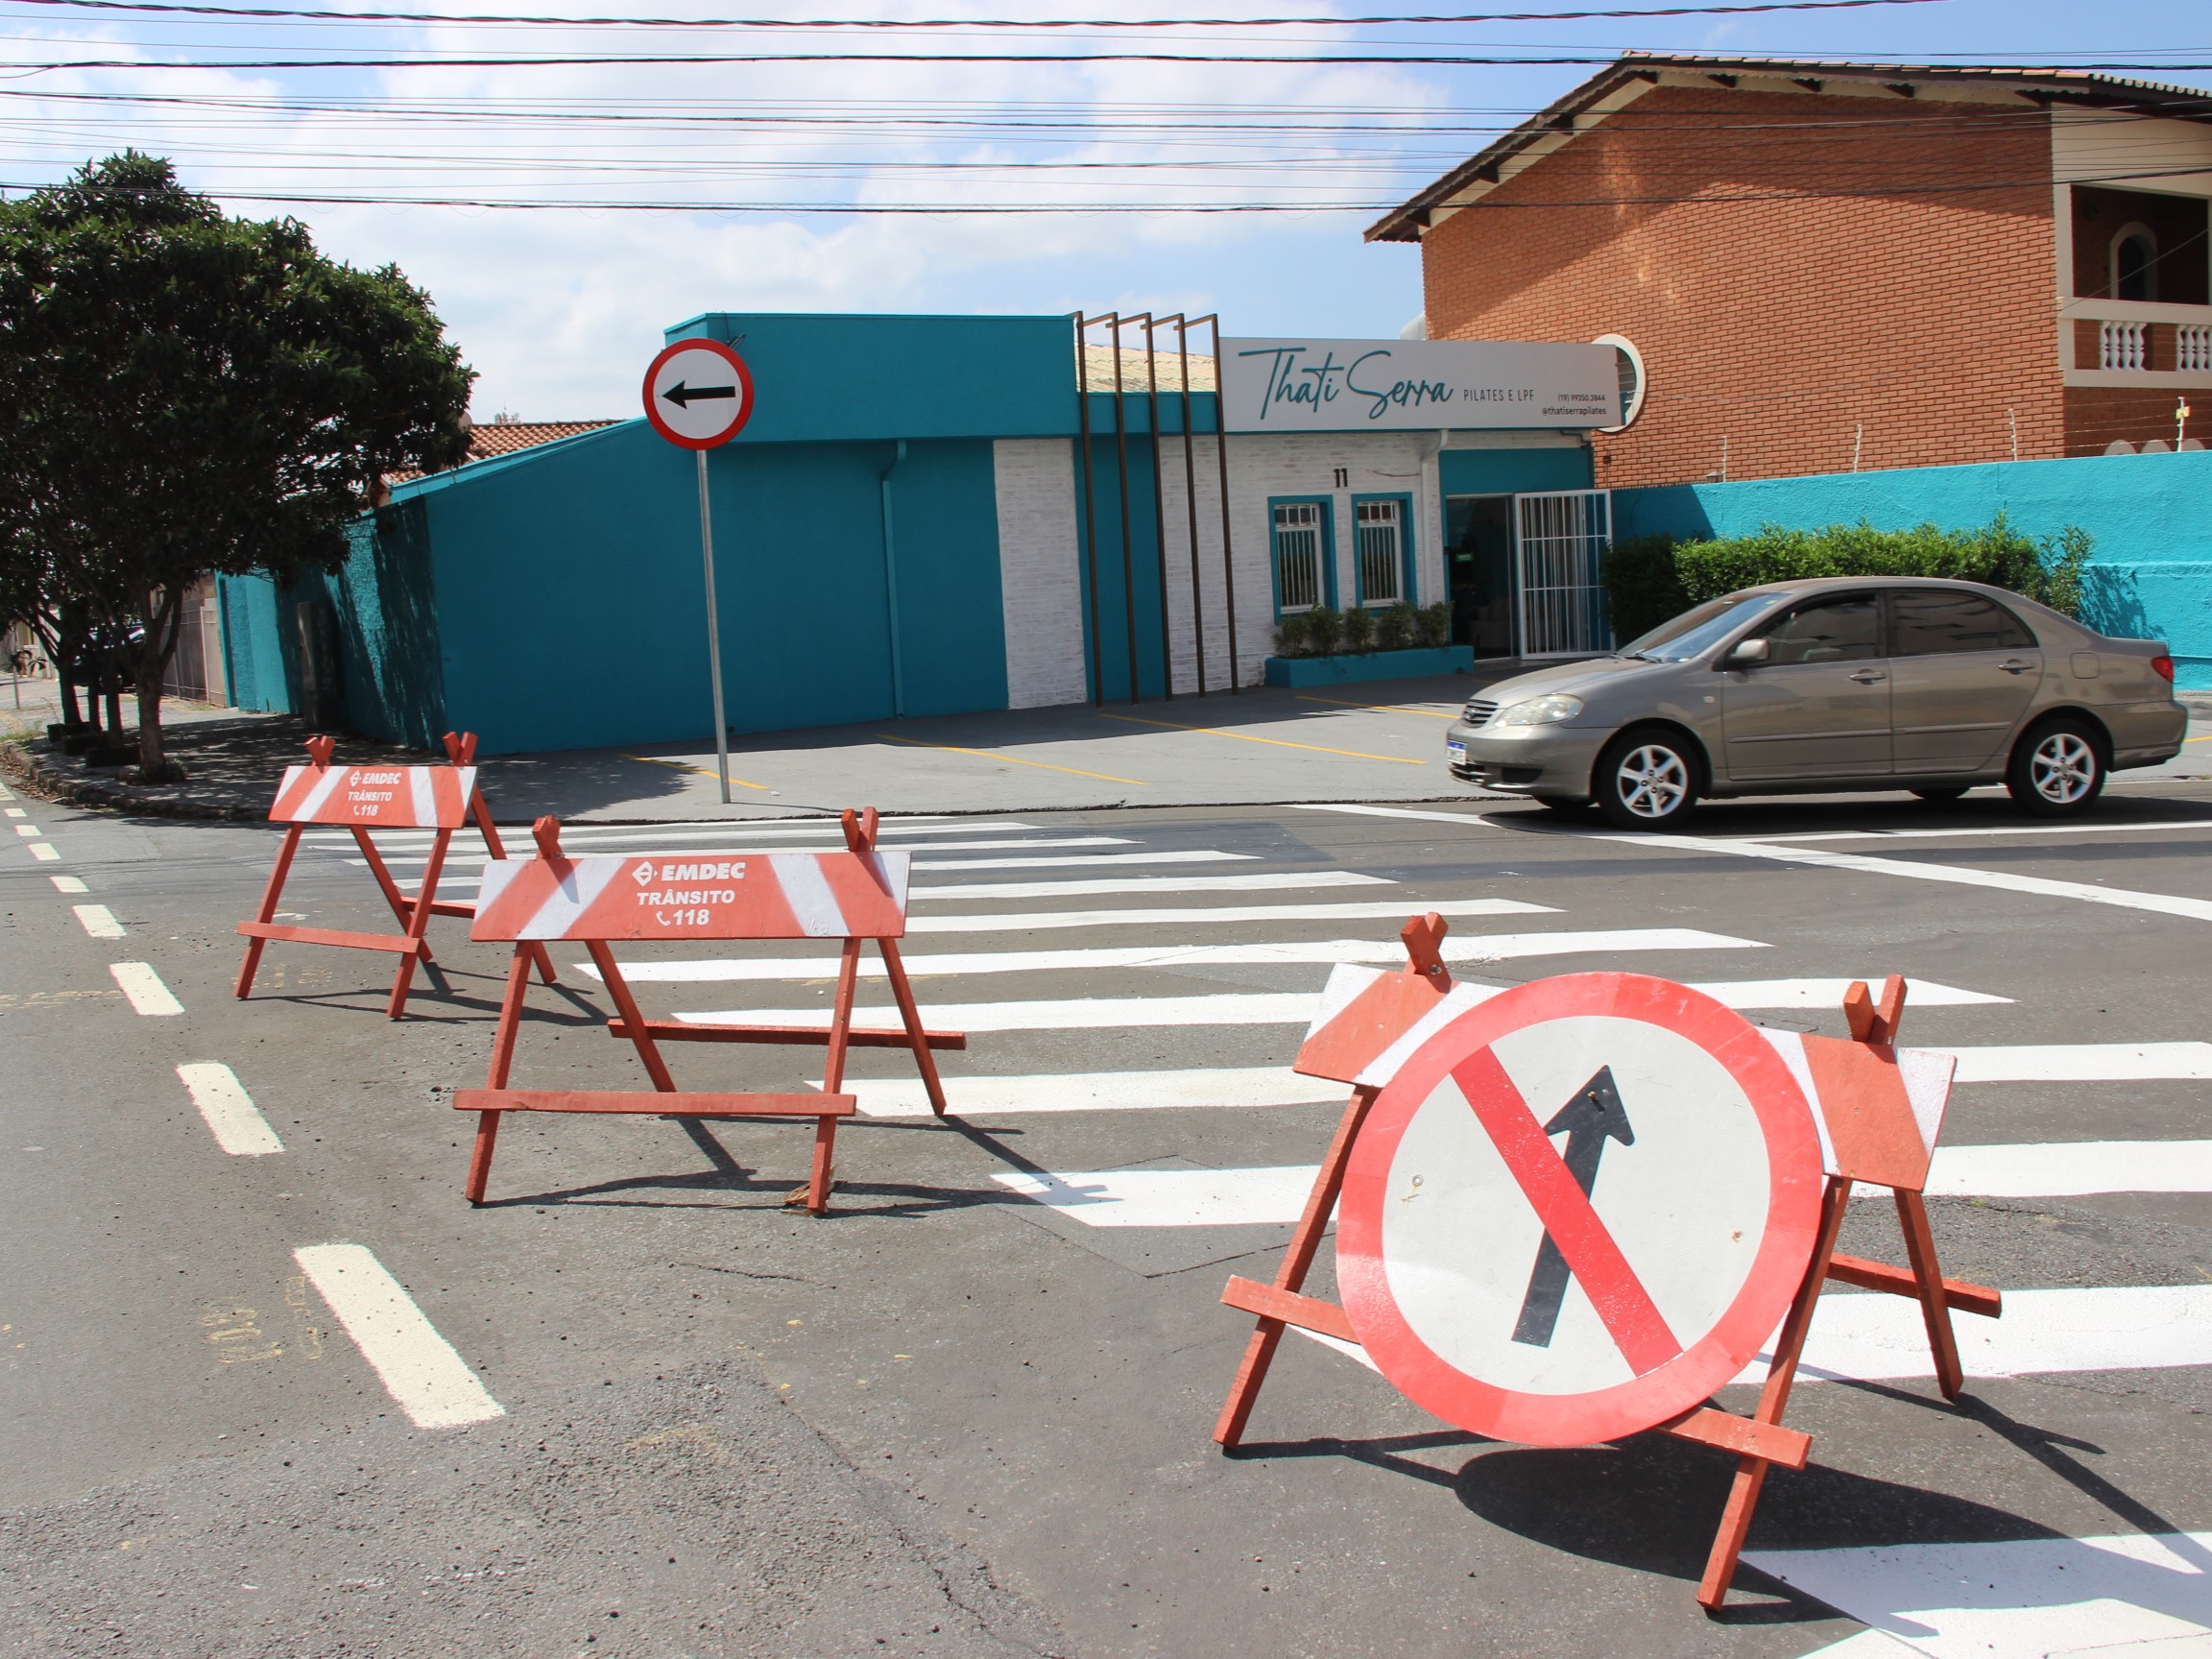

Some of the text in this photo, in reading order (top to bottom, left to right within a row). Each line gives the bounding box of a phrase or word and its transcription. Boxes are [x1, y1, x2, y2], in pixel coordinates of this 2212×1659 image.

[1238, 347, 1455, 421] Thati Serra
[1463, 389, 1534, 402] PILATES E LPF
[1557, 394, 1570, 403] (19)
[1542, 406, 1607, 417] @thatiserrapilates
[1334, 468, 1348, 488] 11
[361, 772, 402, 784] EMDEC
[348, 789, 393, 802] TRÂNSITO
[361, 805, 378, 816] 118
[661, 861, 746, 881] EMDEC
[637, 888, 735, 905] TRÂNSITO
[673, 908, 710, 926] 118
